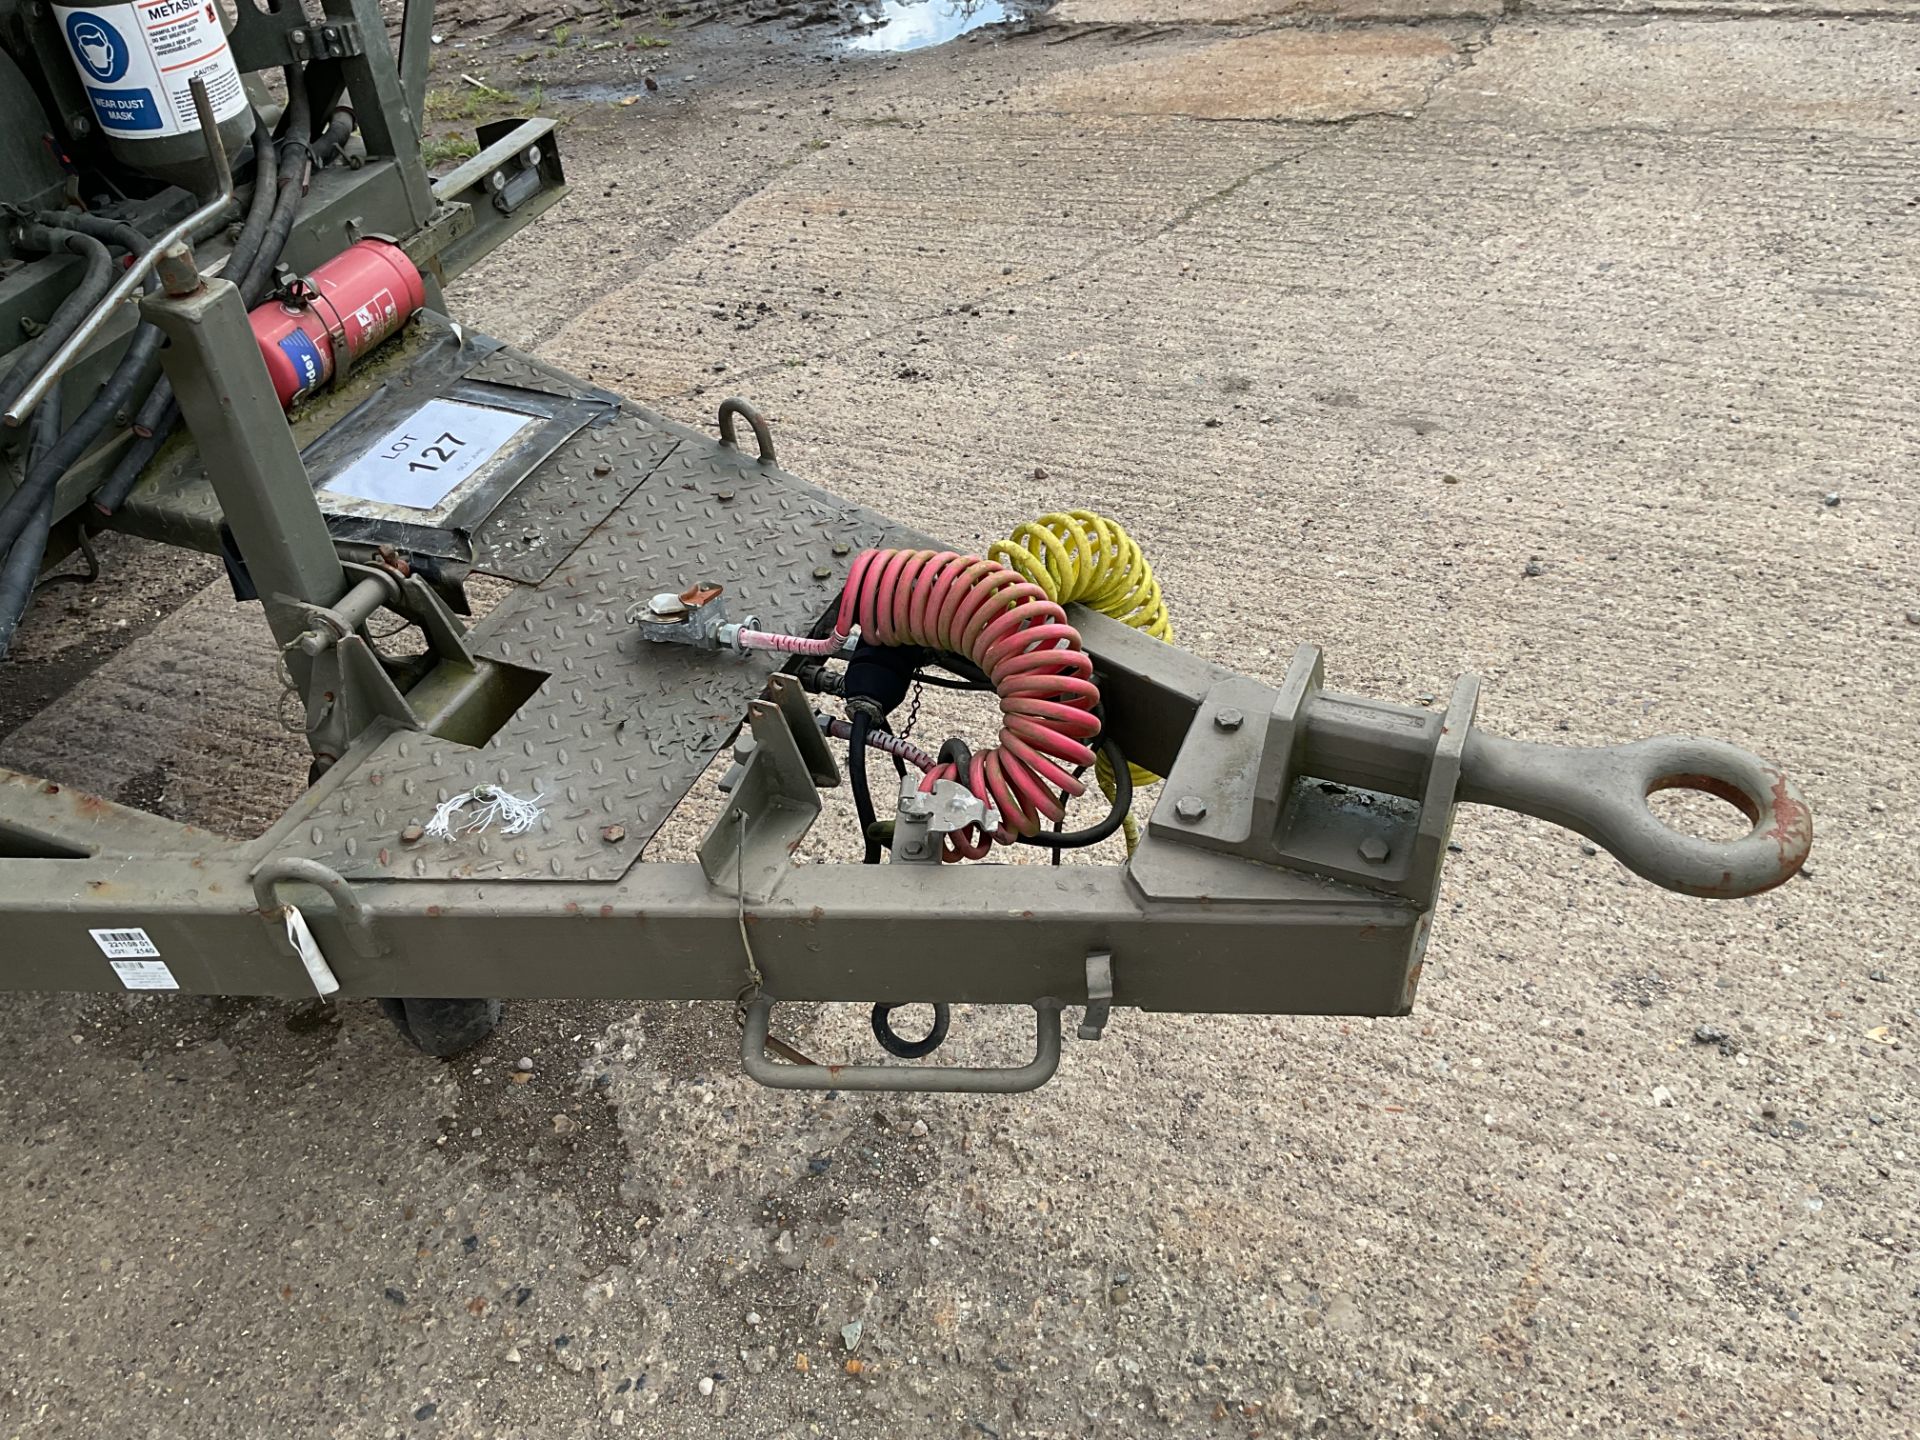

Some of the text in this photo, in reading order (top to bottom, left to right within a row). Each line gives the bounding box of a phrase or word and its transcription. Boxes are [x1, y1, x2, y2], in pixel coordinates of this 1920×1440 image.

[148, 0, 198, 21] METASIL
[149, 27, 171, 37] HARMFUL
[155, 41, 175, 51] POSSIBLE
[156, 44, 186, 57] IRREVERSIBLE
[194, 62, 219, 77] CAUTION
[95, 97, 144, 109] WEAR DUST
[108, 111, 136, 121] MASK
[381, 433, 418, 460] LOT
[408, 432, 467, 472] 127
